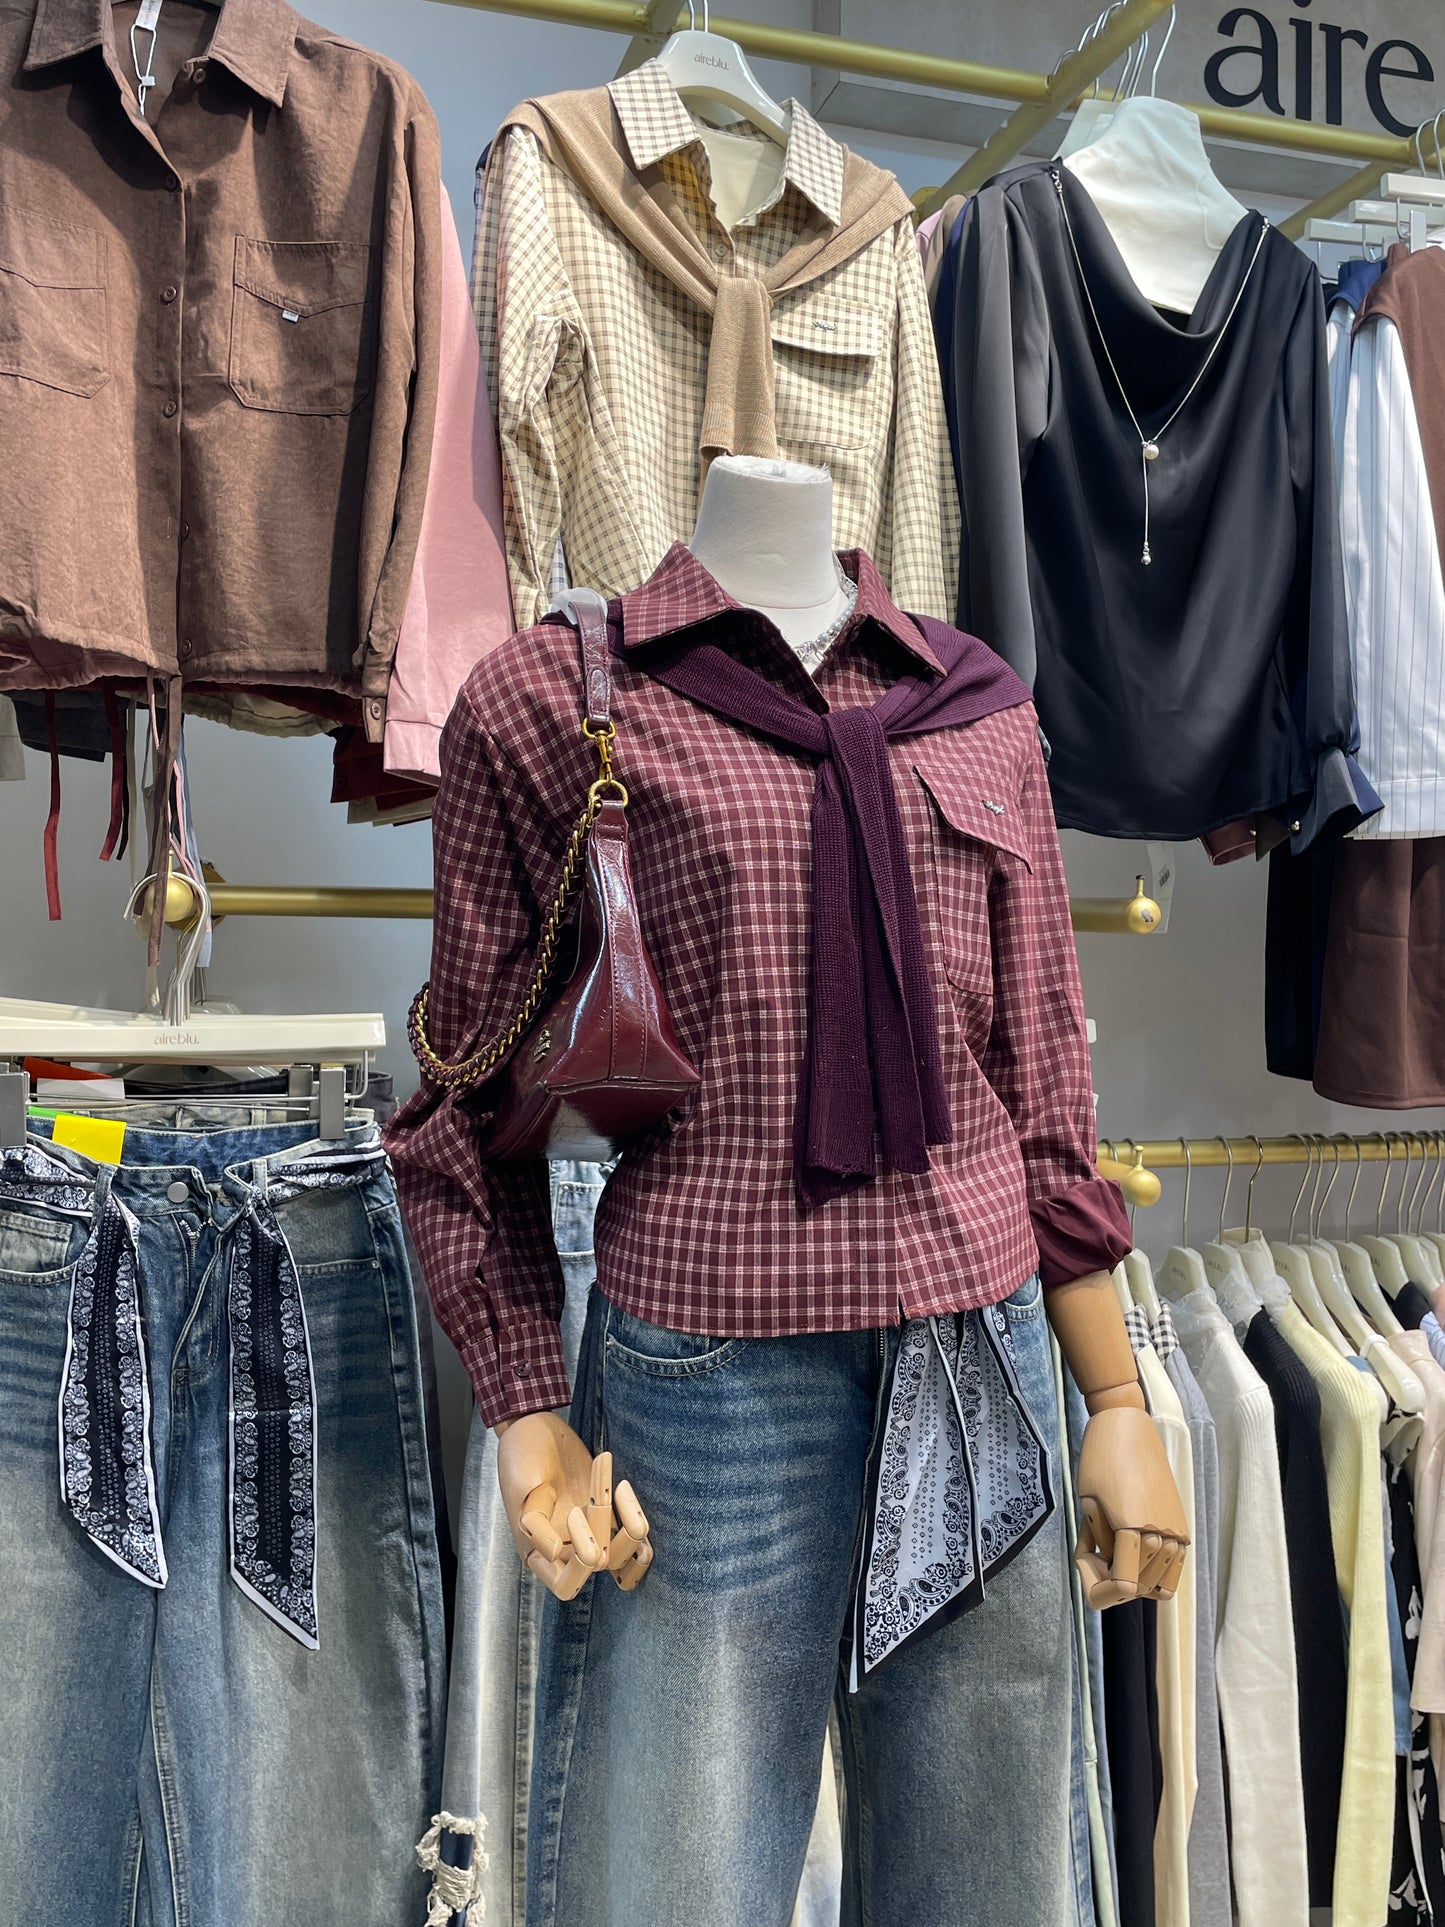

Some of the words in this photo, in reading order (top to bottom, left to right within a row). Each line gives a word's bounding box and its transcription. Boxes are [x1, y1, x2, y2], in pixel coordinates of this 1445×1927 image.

[694, 53, 730, 71] aireblu.
[1204, 0, 1434, 137] aire
[154, 1033, 200, 1045] aireblu.
